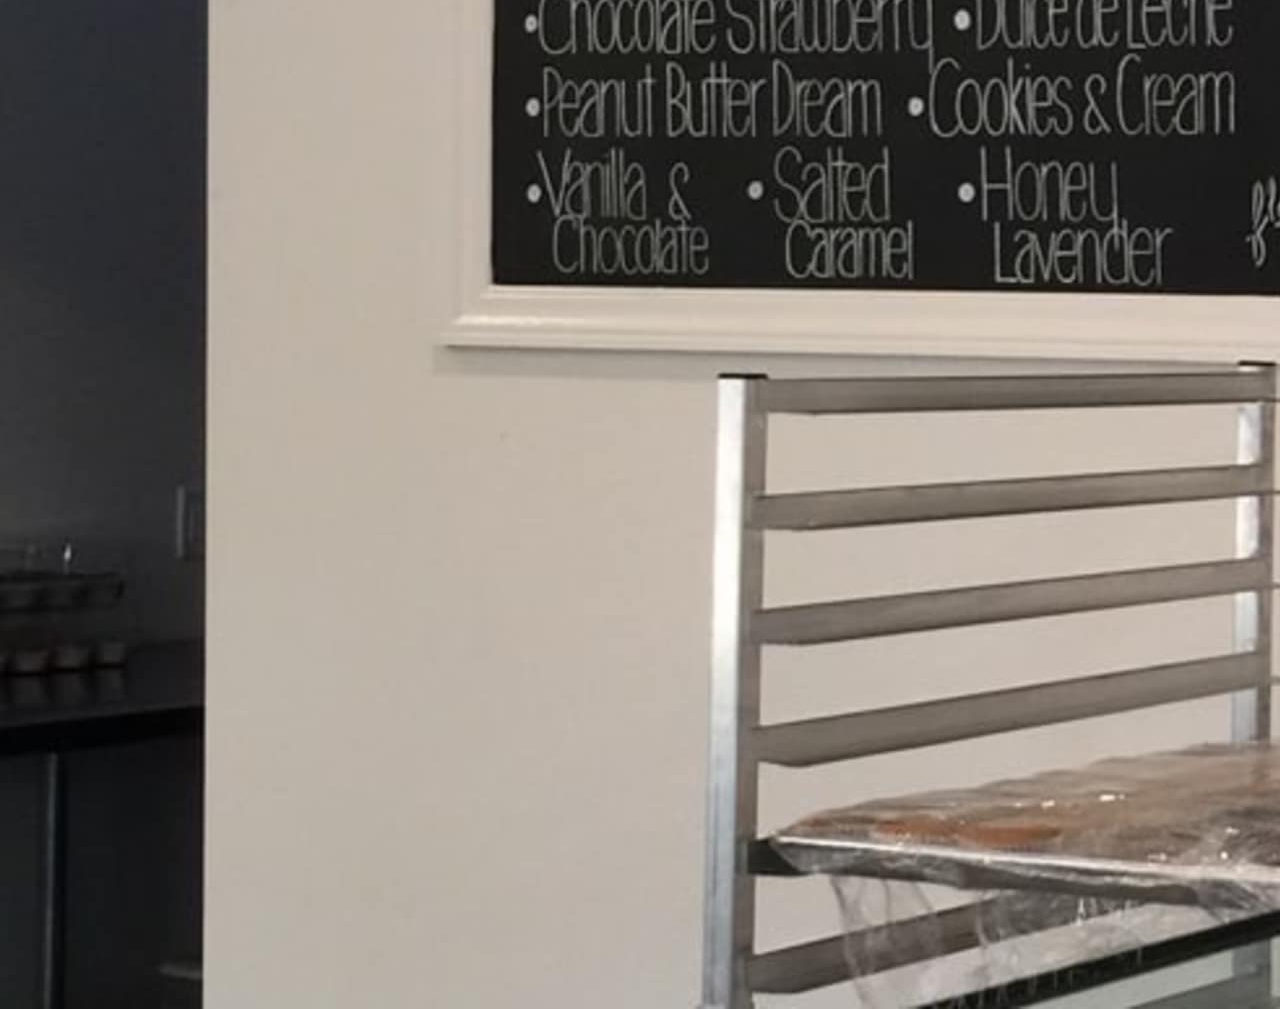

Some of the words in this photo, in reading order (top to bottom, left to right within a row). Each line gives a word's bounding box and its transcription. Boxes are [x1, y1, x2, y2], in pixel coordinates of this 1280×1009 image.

[543, 61, 656, 138] Peanut
[667, 62, 767, 138] Butter
[773, 59, 881, 136] Dream
[930, 57, 1074, 138] Cookies
[1083, 73, 1110, 134] &
[1116, 53, 1236, 136] Cream
[538, 148, 647, 220] Vanilla
[668, 161, 692, 220] &
[774, 146, 891, 223] Salted
[980, 146, 1119, 248] Honey
[552, 217, 710, 275] Chocolate
[785, 220, 915, 279] Caramel
[994, 223, 1174, 284] Lavender
